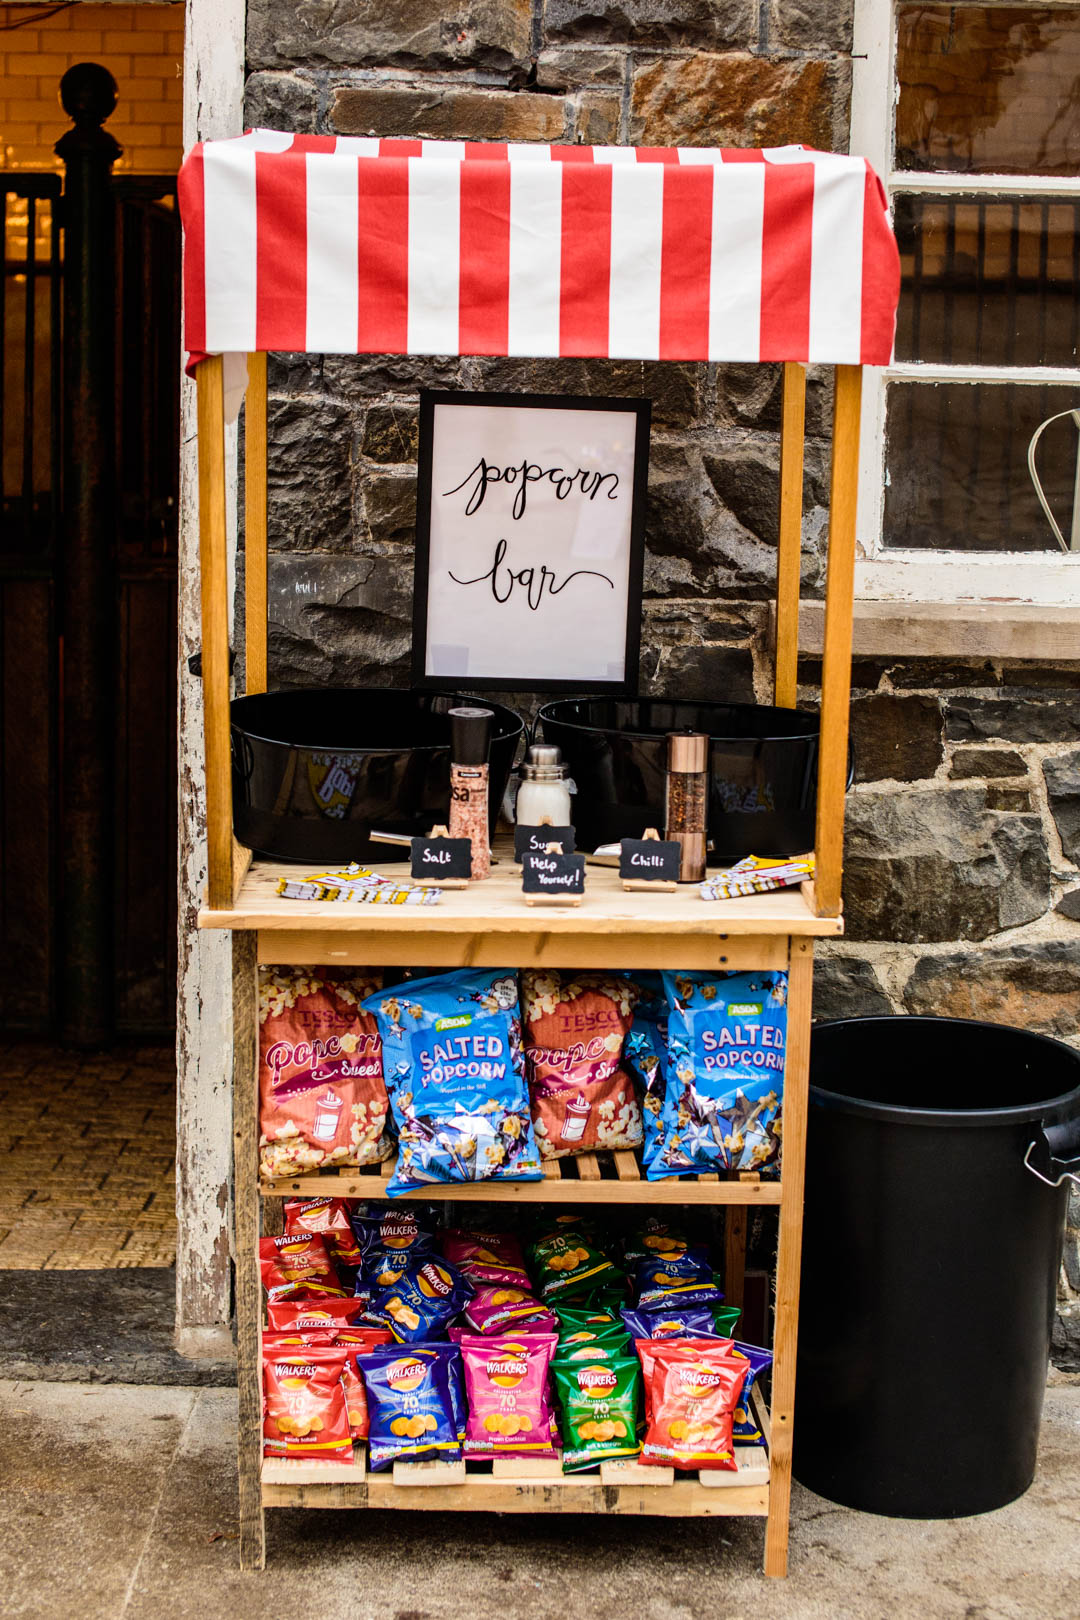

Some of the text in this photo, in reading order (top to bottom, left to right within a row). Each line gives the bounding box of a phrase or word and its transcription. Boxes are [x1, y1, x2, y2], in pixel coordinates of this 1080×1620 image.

[448, 539, 614, 610] bar
[422, 848, 452, 863] Salt
[630, 853, 665, 867] Chilli
[530, 857, 558, 872] Help
[538, 869, 580, 886] Yourself!
[732, 1004, 758, 1013] ASDA
[298, 1010, 357, 1023] TESCO
[440, 1017, 468, 1030] ASDA
[560, 1010, 619, 1028] TESCO
[701, 1024, 784, 1051] SALTED
[420, 1035, 504, 1072] SALTED
[703, 1050, 785, 1072] POPCORN
[340, 1060, 380, 1077] Sweet
[421, 1061, 507, 1088] POPCORN
[380, 1225, 418, 1236] WALKERS
[274, 1233, 313, 1247] WALKERS
[550, 1237, 566, 1250] 70
[291, 1256, 308, 1266] 70
[391, 1254, 408, 1265] 70
[663, 1264, 679, 1273] 70
[421, 1263, 453, 1295] WALKERS
[406, 1290, 422, 1305] 70
[275, 1364, 317, 1377] WALKERS
[385, 1363, 427, 1380] WALKERS
[486, 1361, 528, 1374] WALKERS
[577, 1373, 617, 1386] WALKERS
[679, 1369, 721, 1385] WALKERS
[288, 1397, 305, 1409] 70
[401, 1396, 419, 1410] 70
[499, 1394, 517, 1407] 70
[592, 1402, 610, 1415] 70
[686, 1402, 702, 1414] 70
